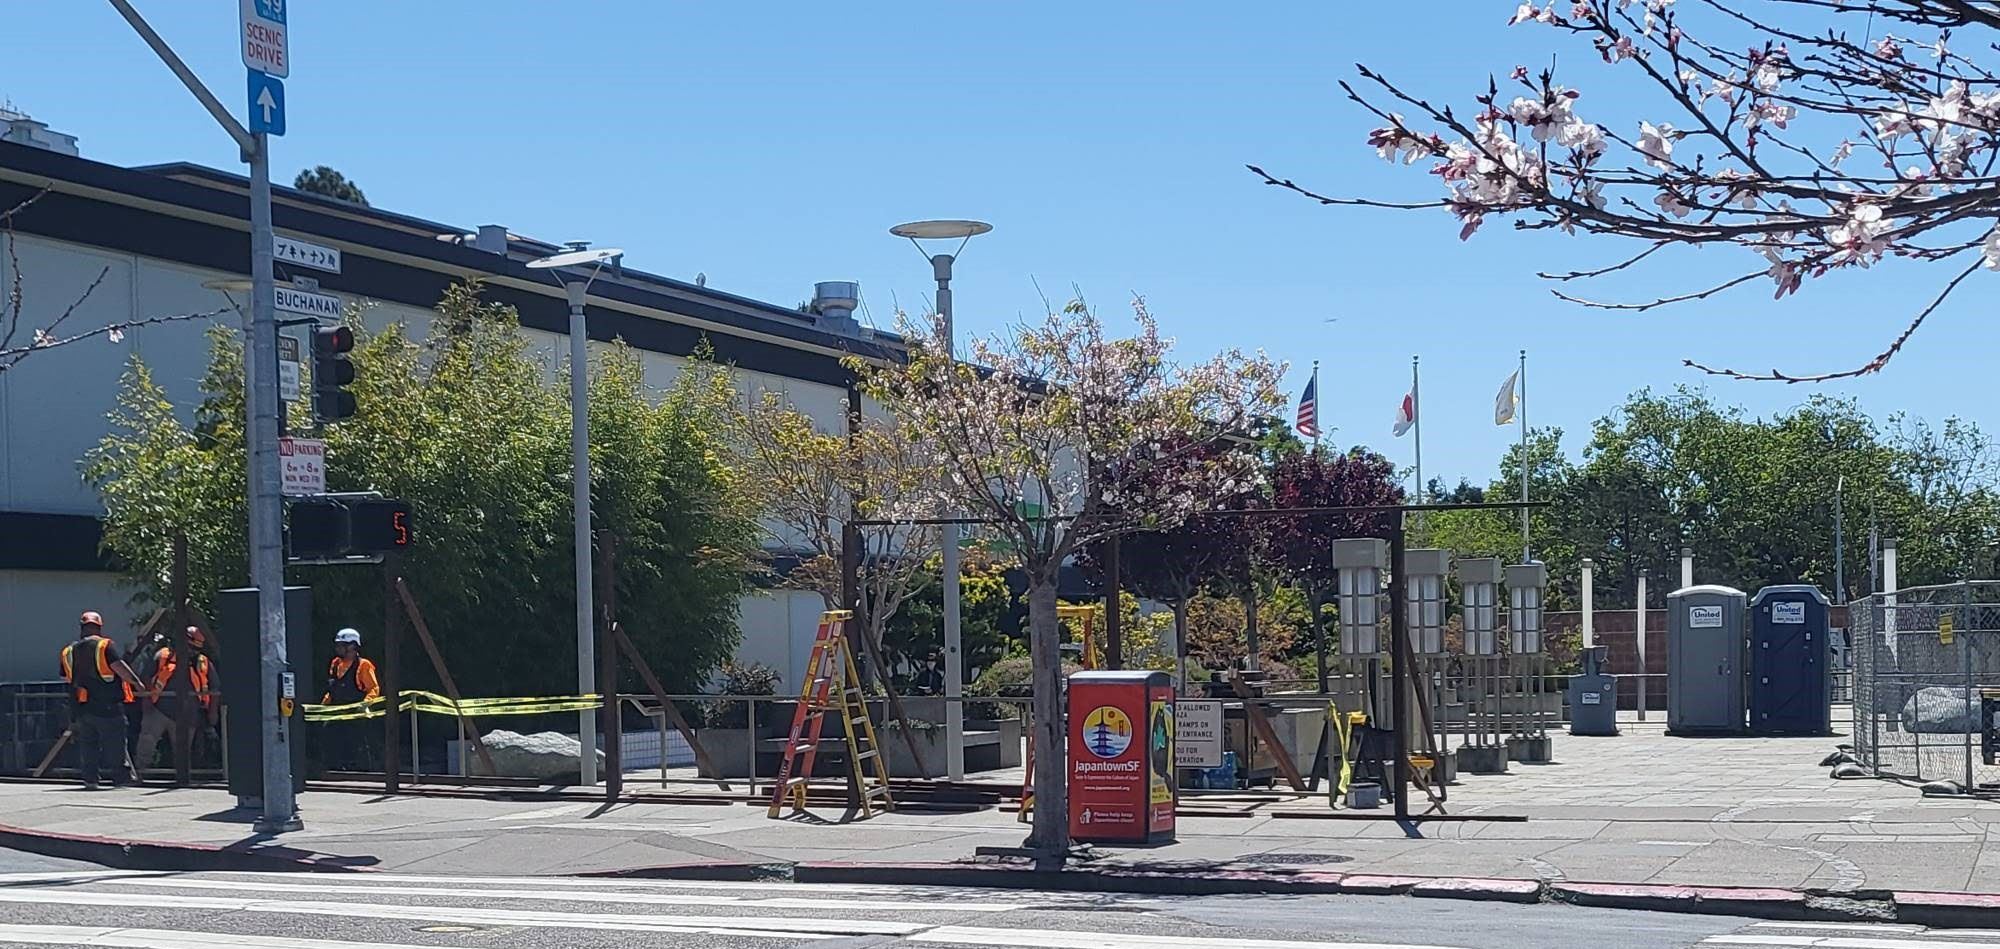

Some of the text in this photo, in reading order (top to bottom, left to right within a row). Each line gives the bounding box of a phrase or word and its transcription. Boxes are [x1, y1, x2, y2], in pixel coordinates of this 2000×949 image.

[246, 22, 283, 47] SCENIC
[247, 41, 283, 67] DRIVE
[276, 291, 339, 315] BUCHANAN
[281, 440, 322, 456] NO PARKING
[393, 511, 406, 545] 5
[1694, 610, 1720, 618] United
[1776, 605, 1801, 613] United
[1183, 704, 1211, 712] ALLOWED
[1182, 730, 1213, 738] ENTRANCE
[1074, 760, 1141, 774] JapantownSF
